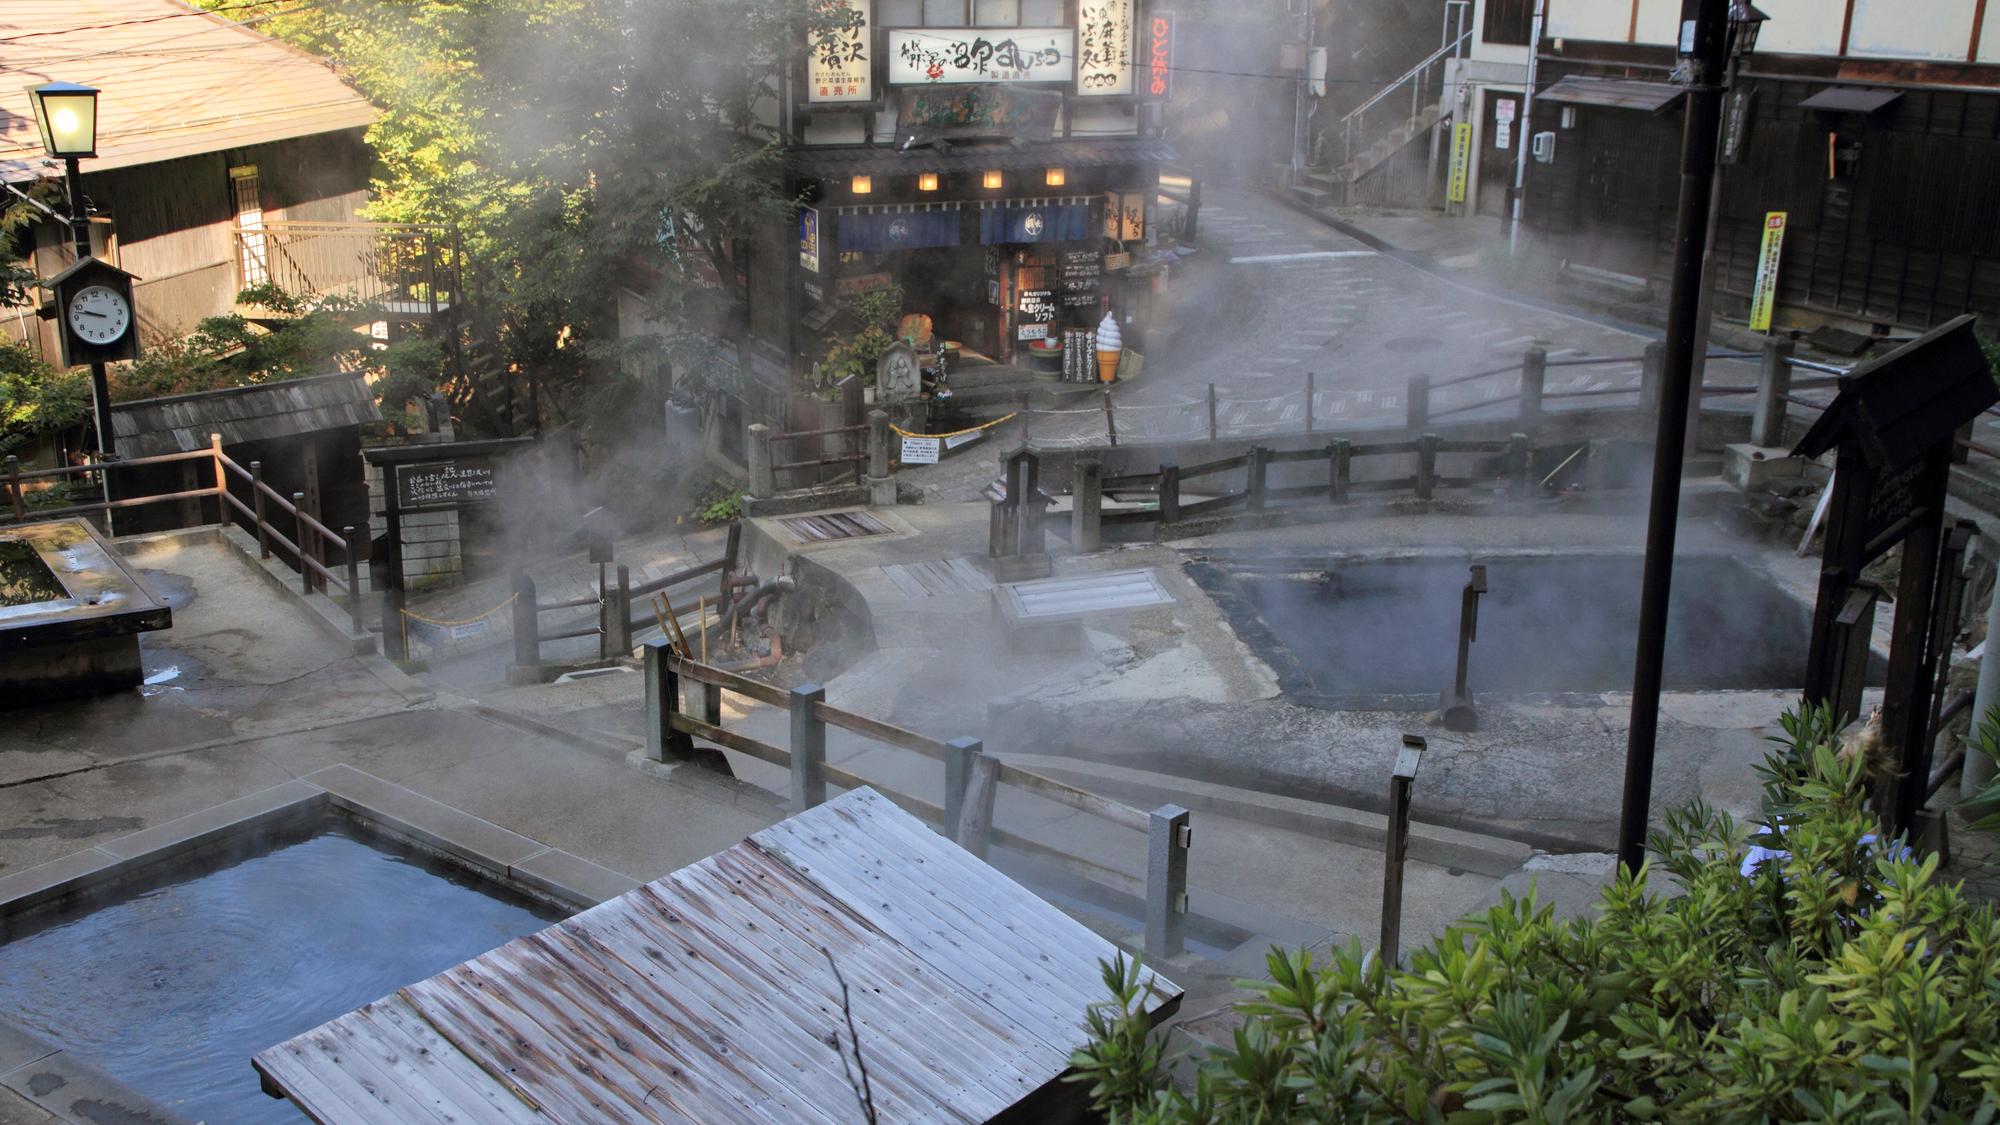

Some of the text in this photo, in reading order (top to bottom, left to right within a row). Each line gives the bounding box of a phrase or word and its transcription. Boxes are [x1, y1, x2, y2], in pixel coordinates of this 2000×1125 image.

[820, 85, 857, 96] 直売所
[1035, 312, 1054, 322] ソフト
